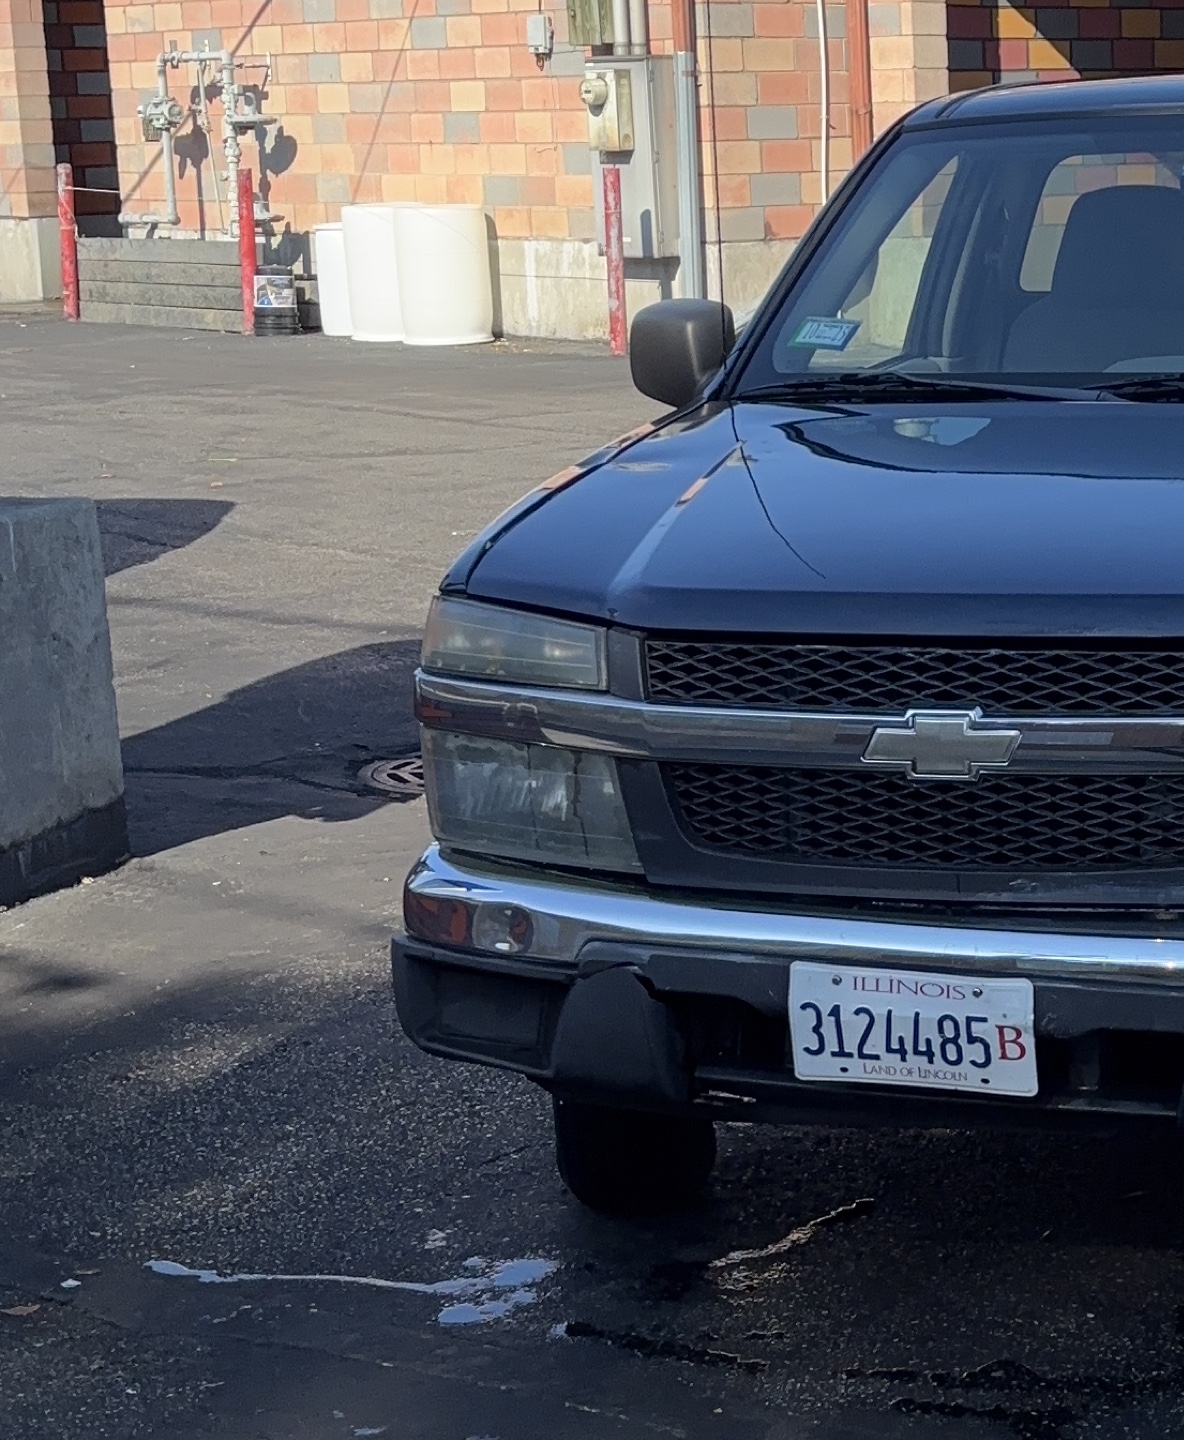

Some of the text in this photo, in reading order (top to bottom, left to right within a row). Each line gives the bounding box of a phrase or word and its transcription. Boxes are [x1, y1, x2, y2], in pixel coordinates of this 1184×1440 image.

[853, 975, 966, 1000] ILLINOIS
[863, 1063, 968, 1082] LAND OF LINCOLN
